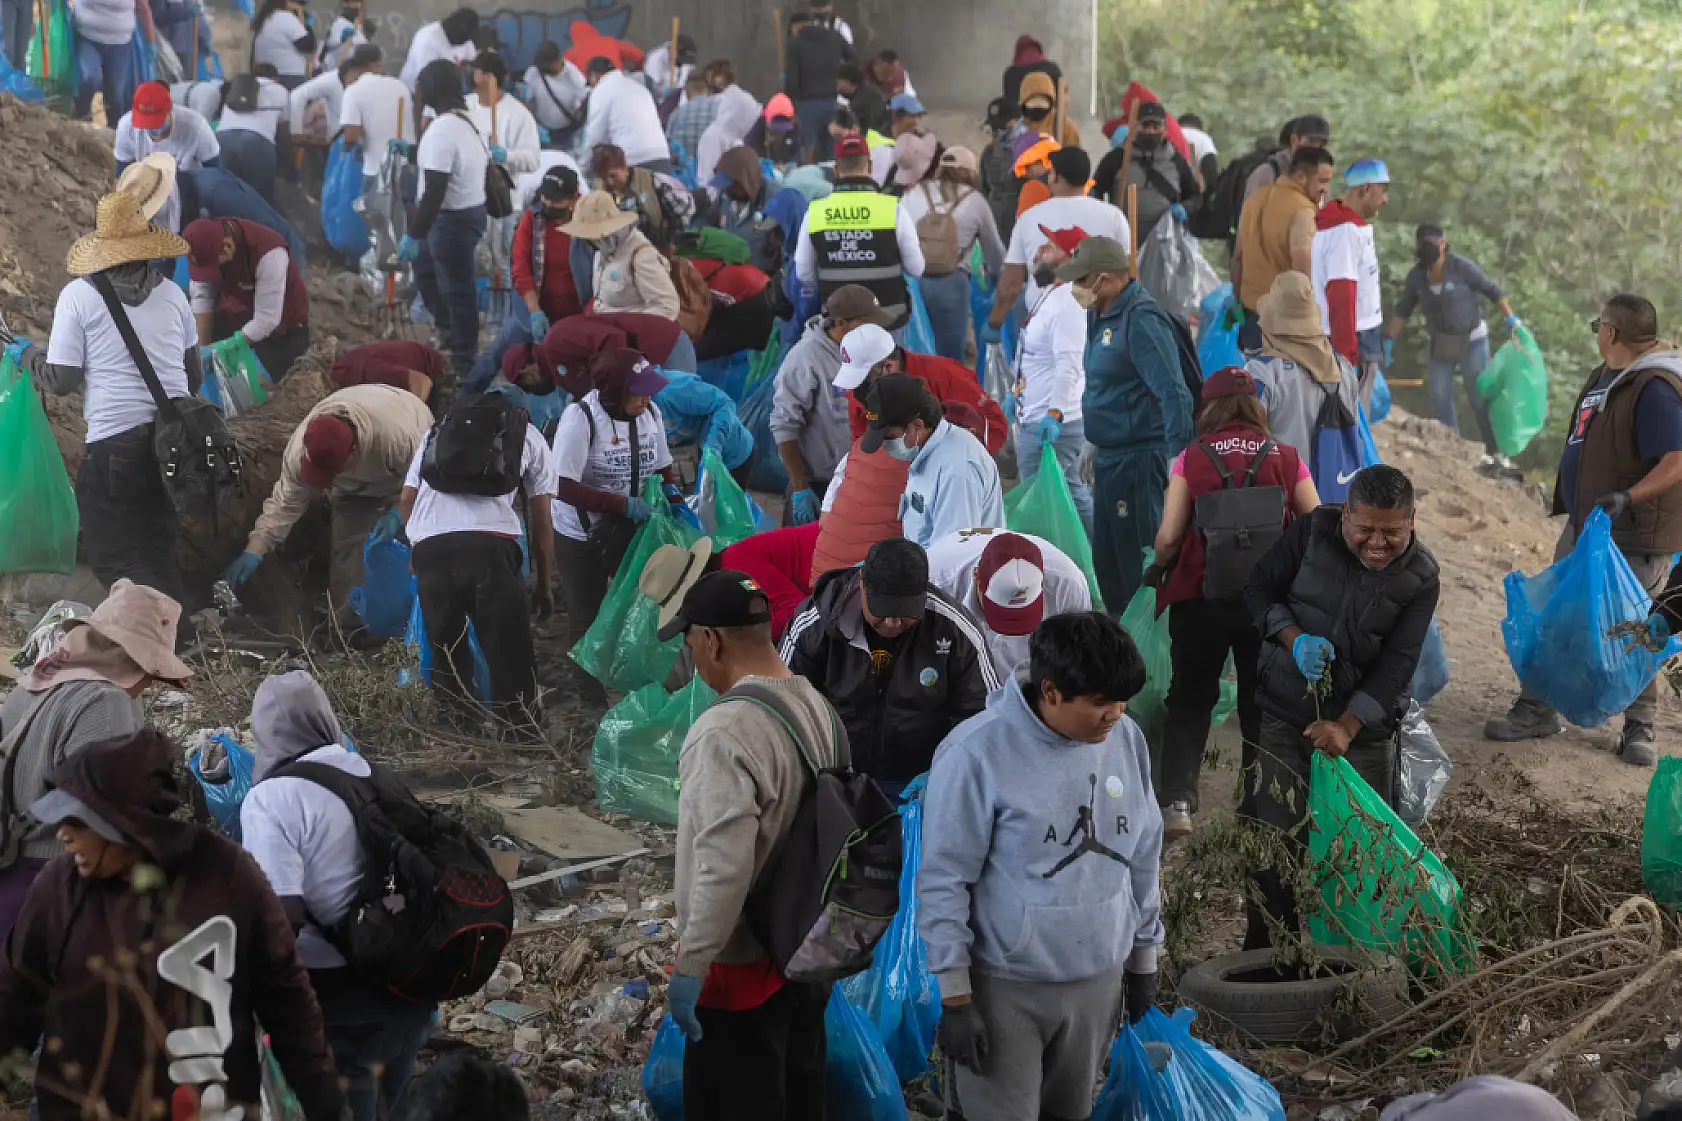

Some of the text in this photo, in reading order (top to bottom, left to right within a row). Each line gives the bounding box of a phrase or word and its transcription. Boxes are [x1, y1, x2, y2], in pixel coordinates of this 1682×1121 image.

[825, 206, 870, 220] SALUD
[824, 230, 873, 241] ESTADO
[841, 240, 858, 250] DE
[1210, 437, 1279, 452] DUCACI
